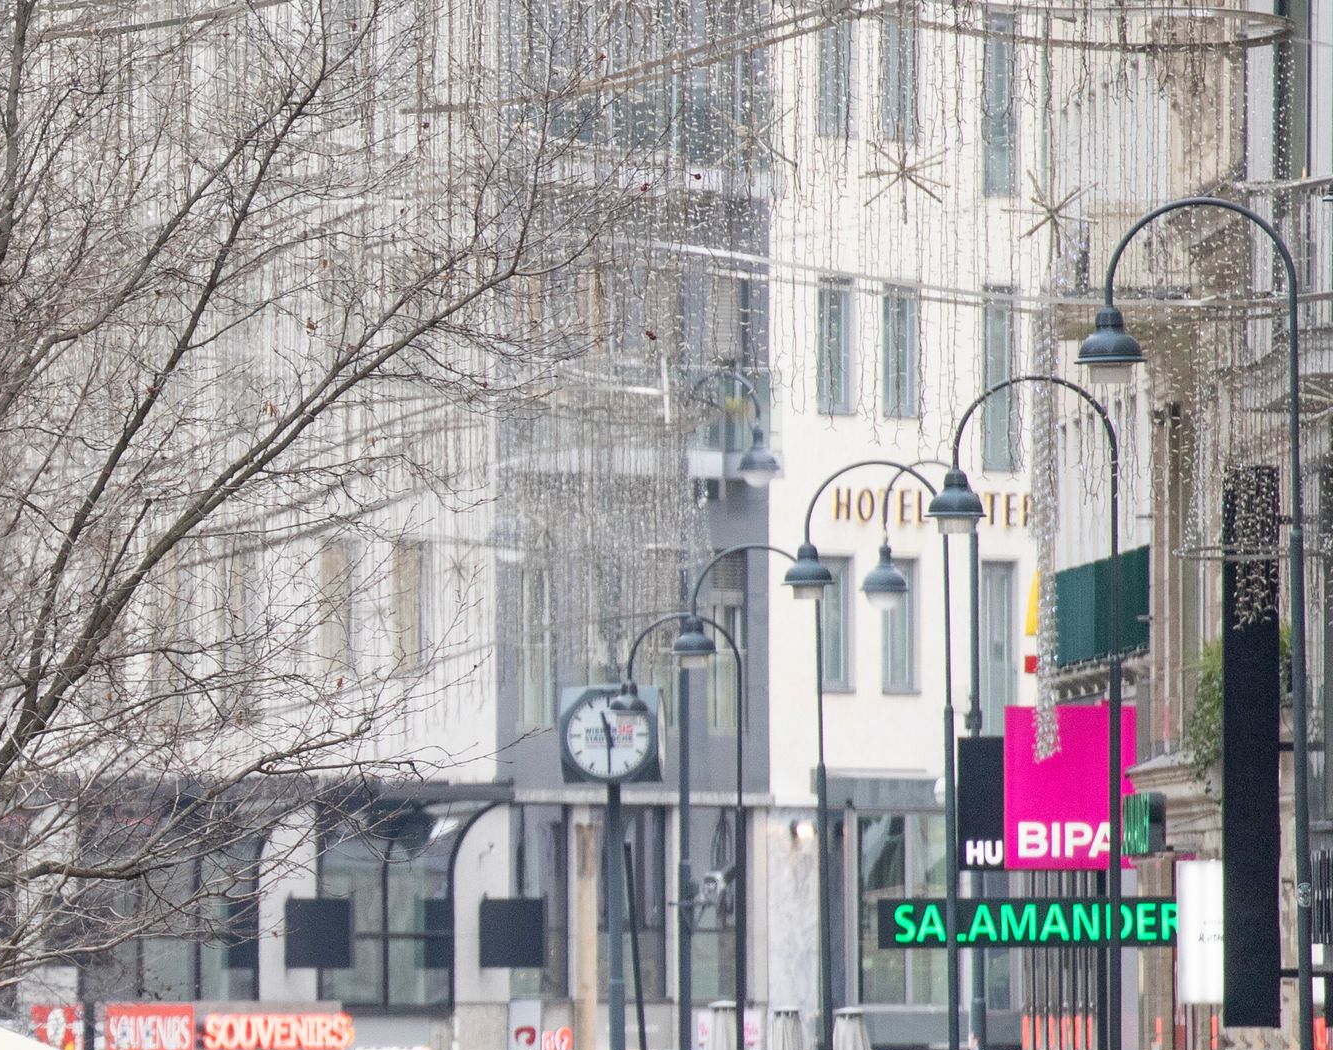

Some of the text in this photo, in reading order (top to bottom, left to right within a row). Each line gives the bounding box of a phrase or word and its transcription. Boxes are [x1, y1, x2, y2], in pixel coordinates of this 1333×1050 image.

[1018, 823, 1112, 859] BIPA
[894, 903, 1178, 943] SAAMANDER
[109, 1015, 191, 1050] SOUVENIRS
[203, 1013, 354, 1050] SOUVENIRS
